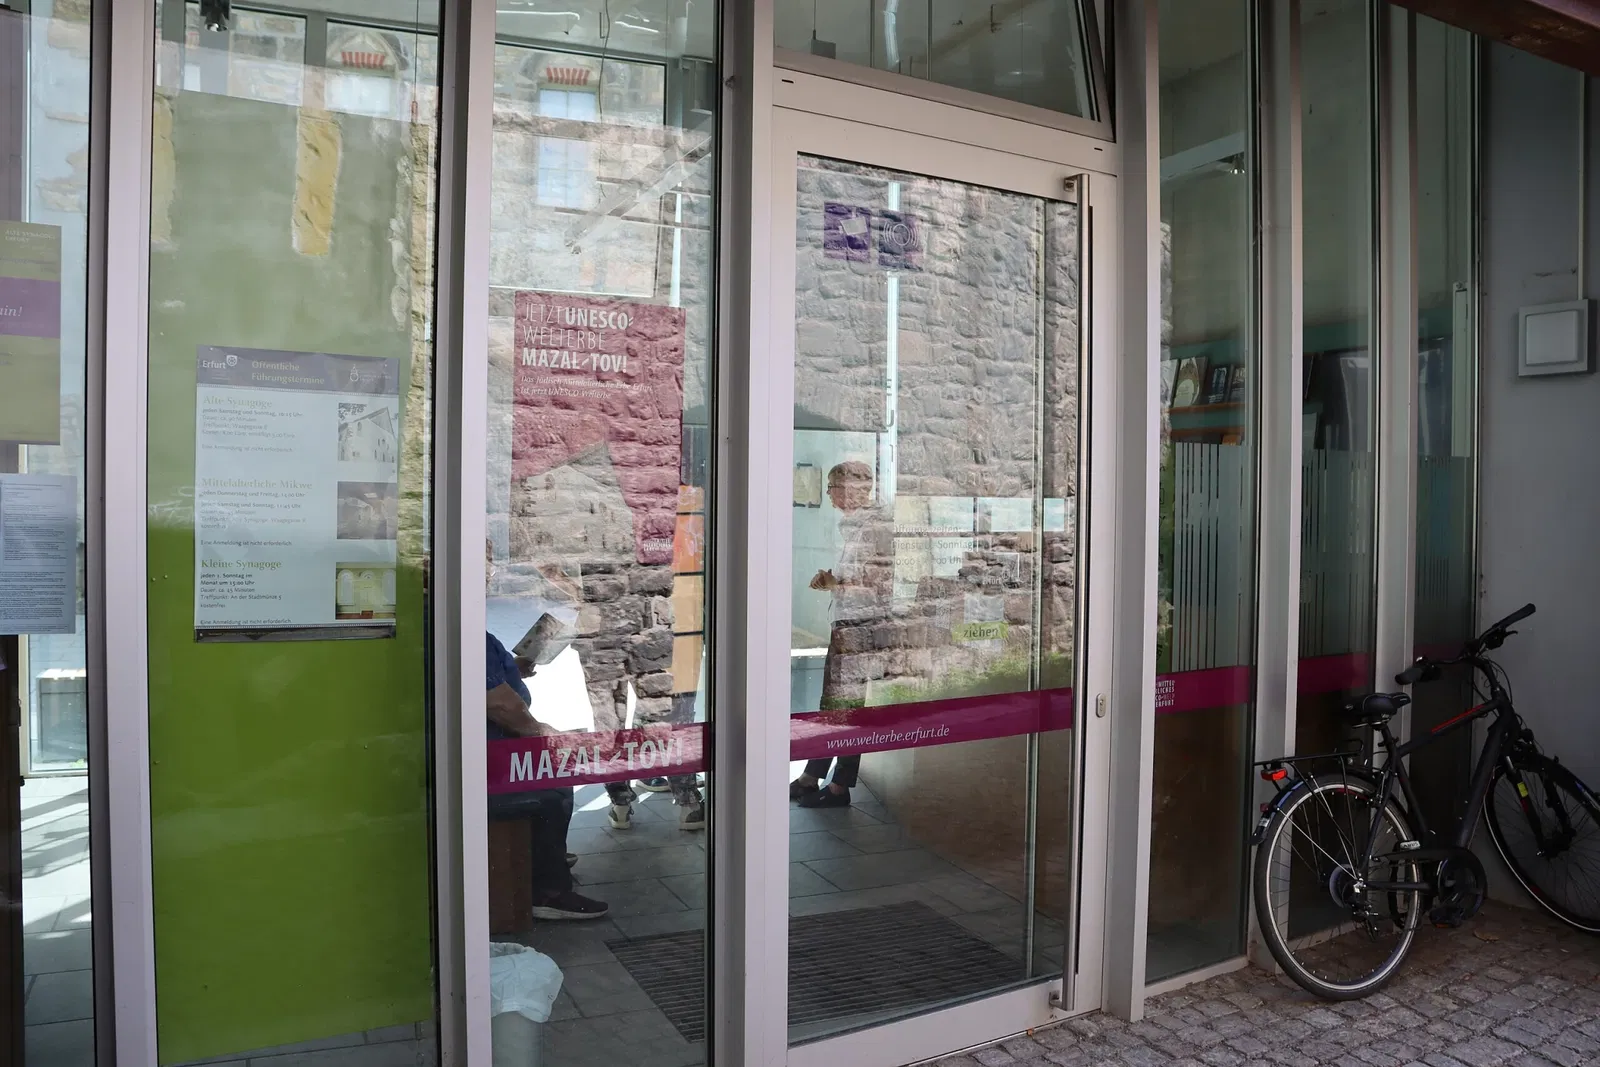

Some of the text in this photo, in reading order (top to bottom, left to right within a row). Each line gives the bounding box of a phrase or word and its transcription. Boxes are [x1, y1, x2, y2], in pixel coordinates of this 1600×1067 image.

[523, 303, 563, 324] JETZT
[523, 325, 606, 350] WELTERBE
[202, 360, 226, 369] Erfurt
[252, 359, 300, 371] Öffentliche
[252, 372, 325, 385] Führungstermine
[203, 395, 272, 410] Alte Synagoge
[201, 477, 313, 490] Mittelalterliche Mikwe
[212, 539, 242, 547] Anmeldung
[201, 559, 282, 571] Kleine Synagoge
[963, 624, 999, 638] ziehen
[826, 723, 950, 749] www.welterbe.erfurt.de
